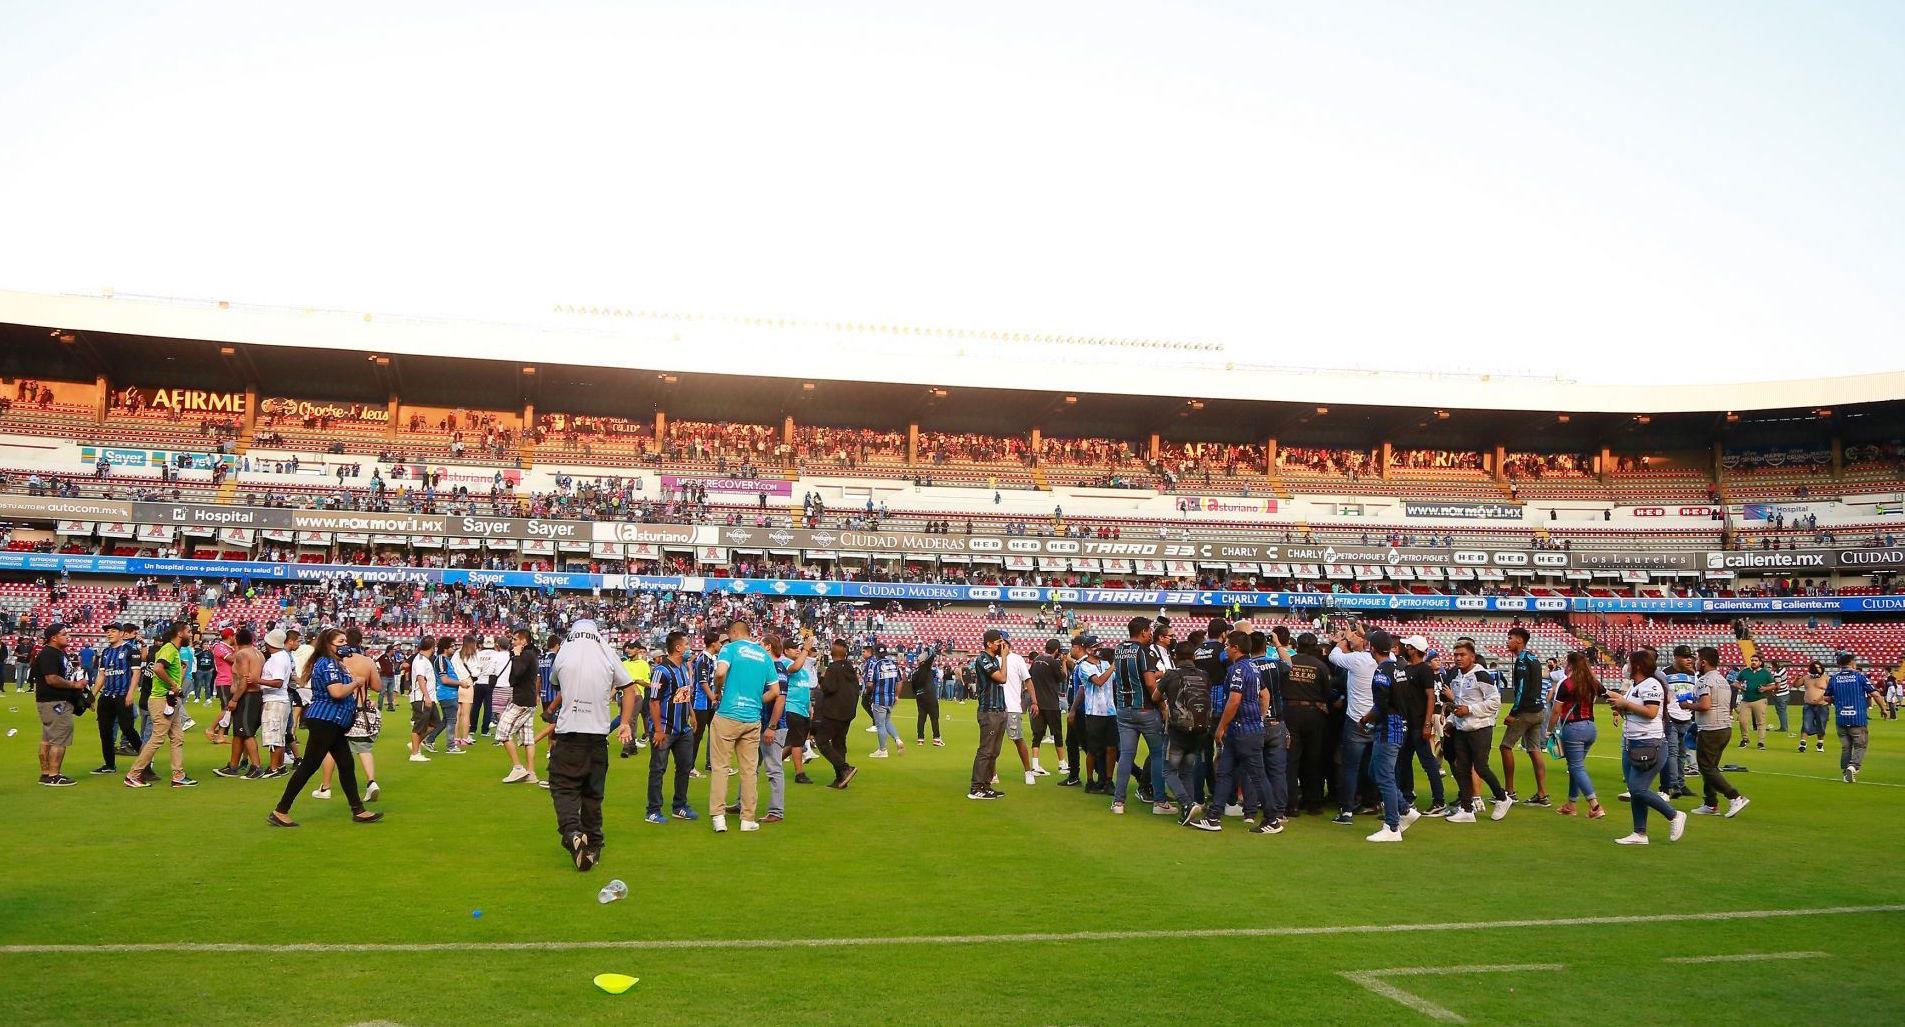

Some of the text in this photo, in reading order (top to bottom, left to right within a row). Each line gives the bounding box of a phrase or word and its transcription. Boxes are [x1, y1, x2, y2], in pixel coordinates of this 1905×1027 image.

[152, 388, 246, 412] AFIRME
[48, 504, 118, 515] autocom.mx
[1207, 498, 1258, 512] asturiano
[195, 510, 254, 523] Hospital
[622, 524, 688, 542] asturiano
[840, 532, 898, 548] CIUDAD
[902, 538, 965, 550] MADERAS
[1084, 542, 1195, 556] TARRO 33
[1222, 546, 1258, 556] CHARLY
[1288, 549, 1323, 558] CHARLY
[1581, 554, 1686, 564] Los Laureles
[1725, 553, 1824, 566] caliente.mx
[1841, 552, 1903, 564] CIUDAD
[206, 565, 229, 573] pasión
[860, 585, 958, 598] CIUDAD MADERAS
[1085, 590, 1197, 603] TARRO 33
[1222, 595, 1258, 604] CHARLY
[1288, 596, 1324, 604] CHARLY
[1588, 599, 1693, 608] Los Laureles
[1714, 601, 1769, 609] caliente.mx
[1783, 600, 1840, 608] caliente.mx
